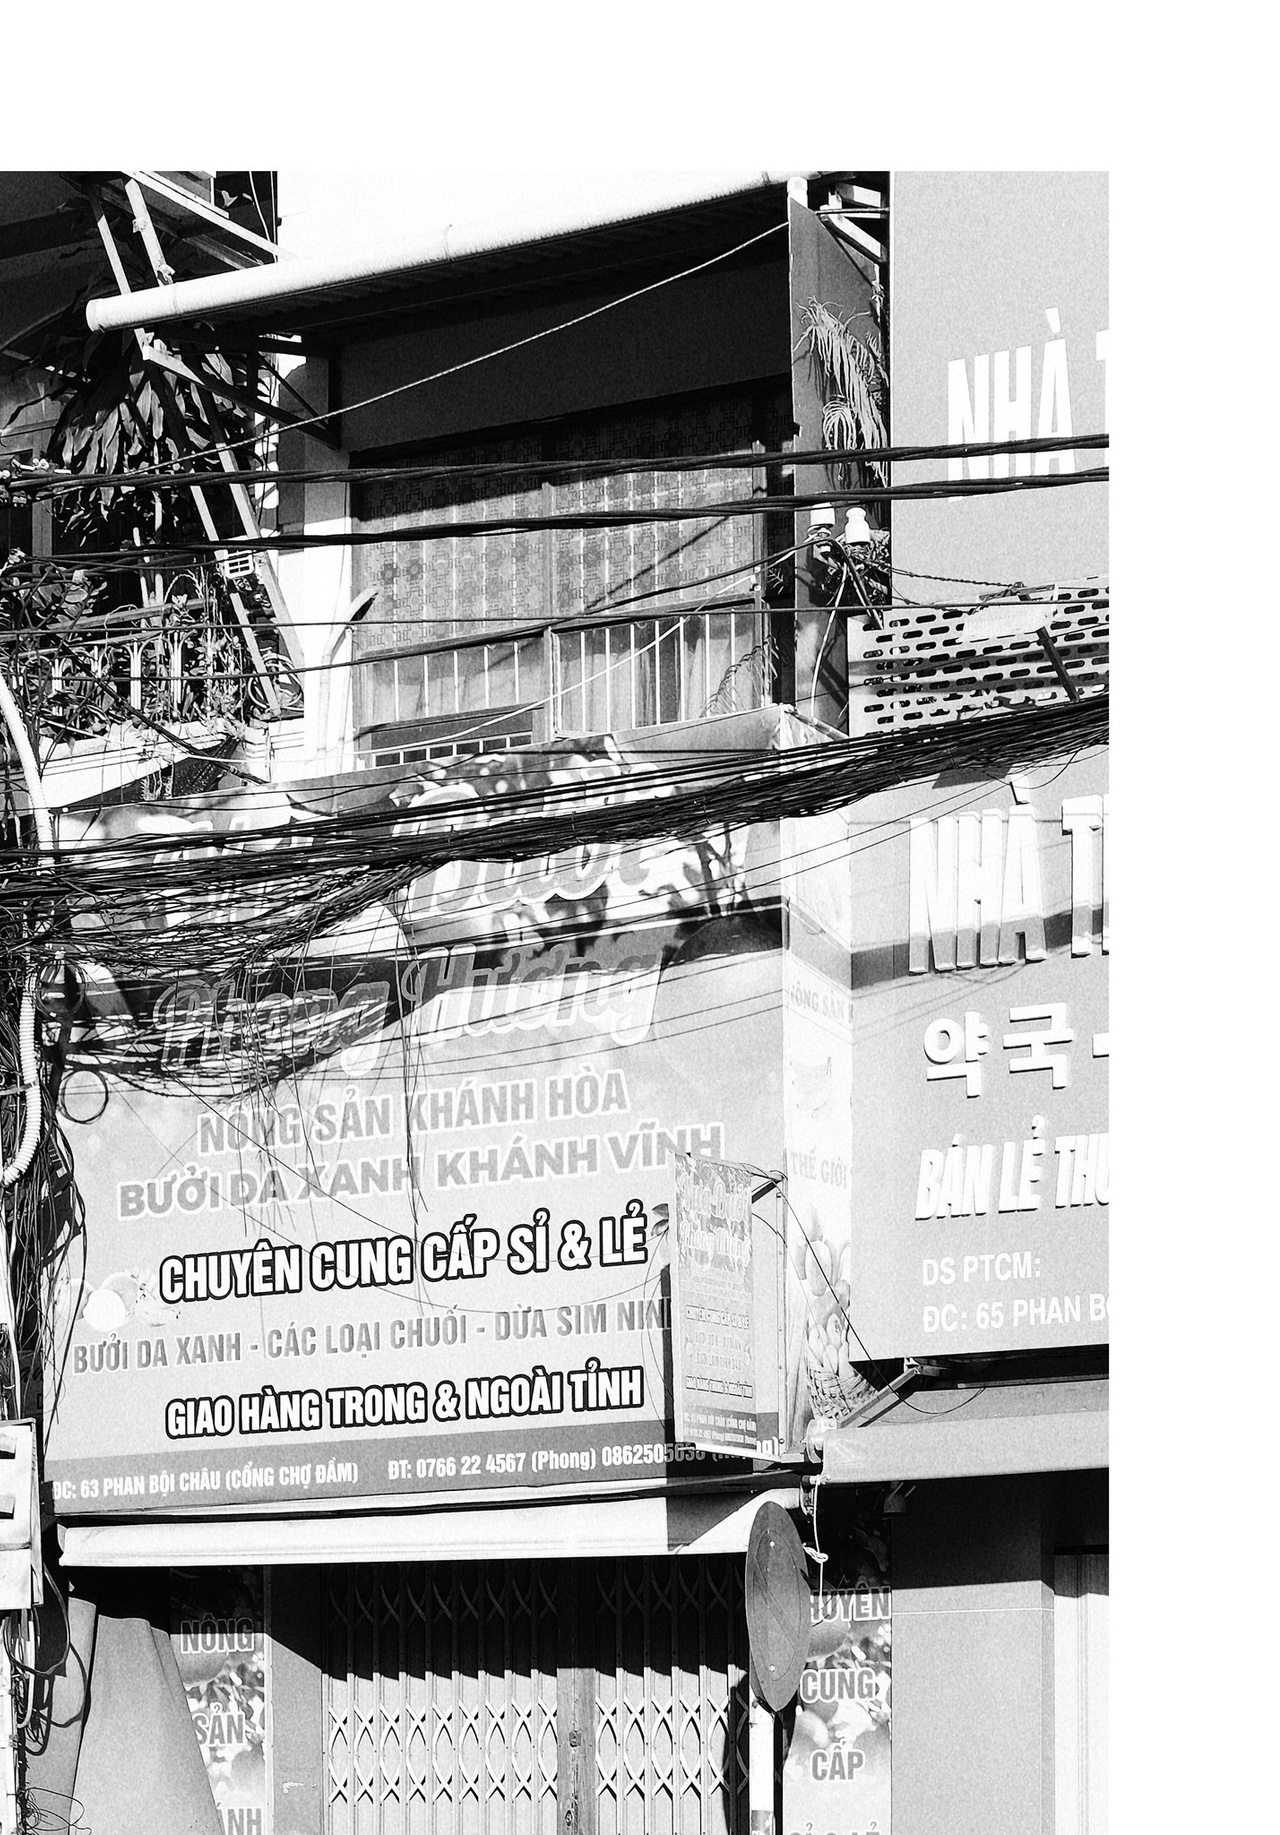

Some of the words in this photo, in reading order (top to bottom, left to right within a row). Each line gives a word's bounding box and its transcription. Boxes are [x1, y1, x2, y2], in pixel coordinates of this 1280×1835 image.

[909, 774, 1047, 976] NHÀ
[312, 1087, 396, 1146] SẢN
[406, 1077, 539, 1134] KHÁNH
[547, 1068, 629, 1121] HÒA
[119, 1163, 224, 1221] BƯỞI
[231, 1168, 293, 1211] DA
[434, 1130, 602, 1190] KHÁNH
[915, 1133, 994, 1220] BÁN
[998, 1114, 1045, 1214] LẺ
[160, 1239, 306, 1303] CHUYÊN
[309, 1236, 414, 1293] CUNG
[419, 1215, 499, 1282] CẤP
[508, 1208, 551, 1273] SỈ
[561, 1227, 591, 1269] &
[600, 1200, 647, 1266] LẺ
[922, 1256, 957, 1286] DS
[963, 1252, 1040, 1283] PTCM:
[73, 1333, 129, 1374] BƯỞI
[137, 1337, 168, 1367] DA
[175, 1332, 242, 1367] XANH
[267, 1319, 317, 1360] CÁC
[325, 1323, 380, 1361] LOẠI
[389, 1306, 467, 1350] CHUỐI
[495, 1304, 548, 1342] DỪA
[557, 1301, 608, 1337] SIM
[922, 1304, 967, 1333] ĐC:
[976, 1302, 1004, 1329] 65
[1012, 1295, 1081, 1326] PHAN
[166, 1396, 235, 1440] GIAO
[239, 1386, 321, 1434] HÀNG
[326, 1382, 426, 1429] TRONG
[434, 1381, 462, 1421] &
[465, 1365, 567, 1418] NGOÀI
[571, 1356, 644, 1412] TỈNH
[53, 1481, 76, 1500] ĐC:
[80, 1479, 99, 1498] 63
[103, 1476, 145, 1497] PHAN
[149, 1470, 174, 1497] BỘI
[179, 1468, 221, 1493] CHÂU
[226, 1462, 275, 1491] (CỔNG
[278, 1463, 311, 1490] CHỢ
[315, 1457, 359, 1484] ĐẦM)
[388, 1459, 412, 1480] ĐT:
[416, 1457, 456, 1477] 0766
[460, 1455, 481, 1475] 22
[485, 1452, 526, 1474] 4567
[531, 1448, 596, 1473] (Phong)
[180, 1615, 255, 1654] NÔNG
[800, 1669, 877, 1703] CUNG
[194, 1703, 245, 1747] SẢN
[810, 1739, 864, 1781] CẤP
